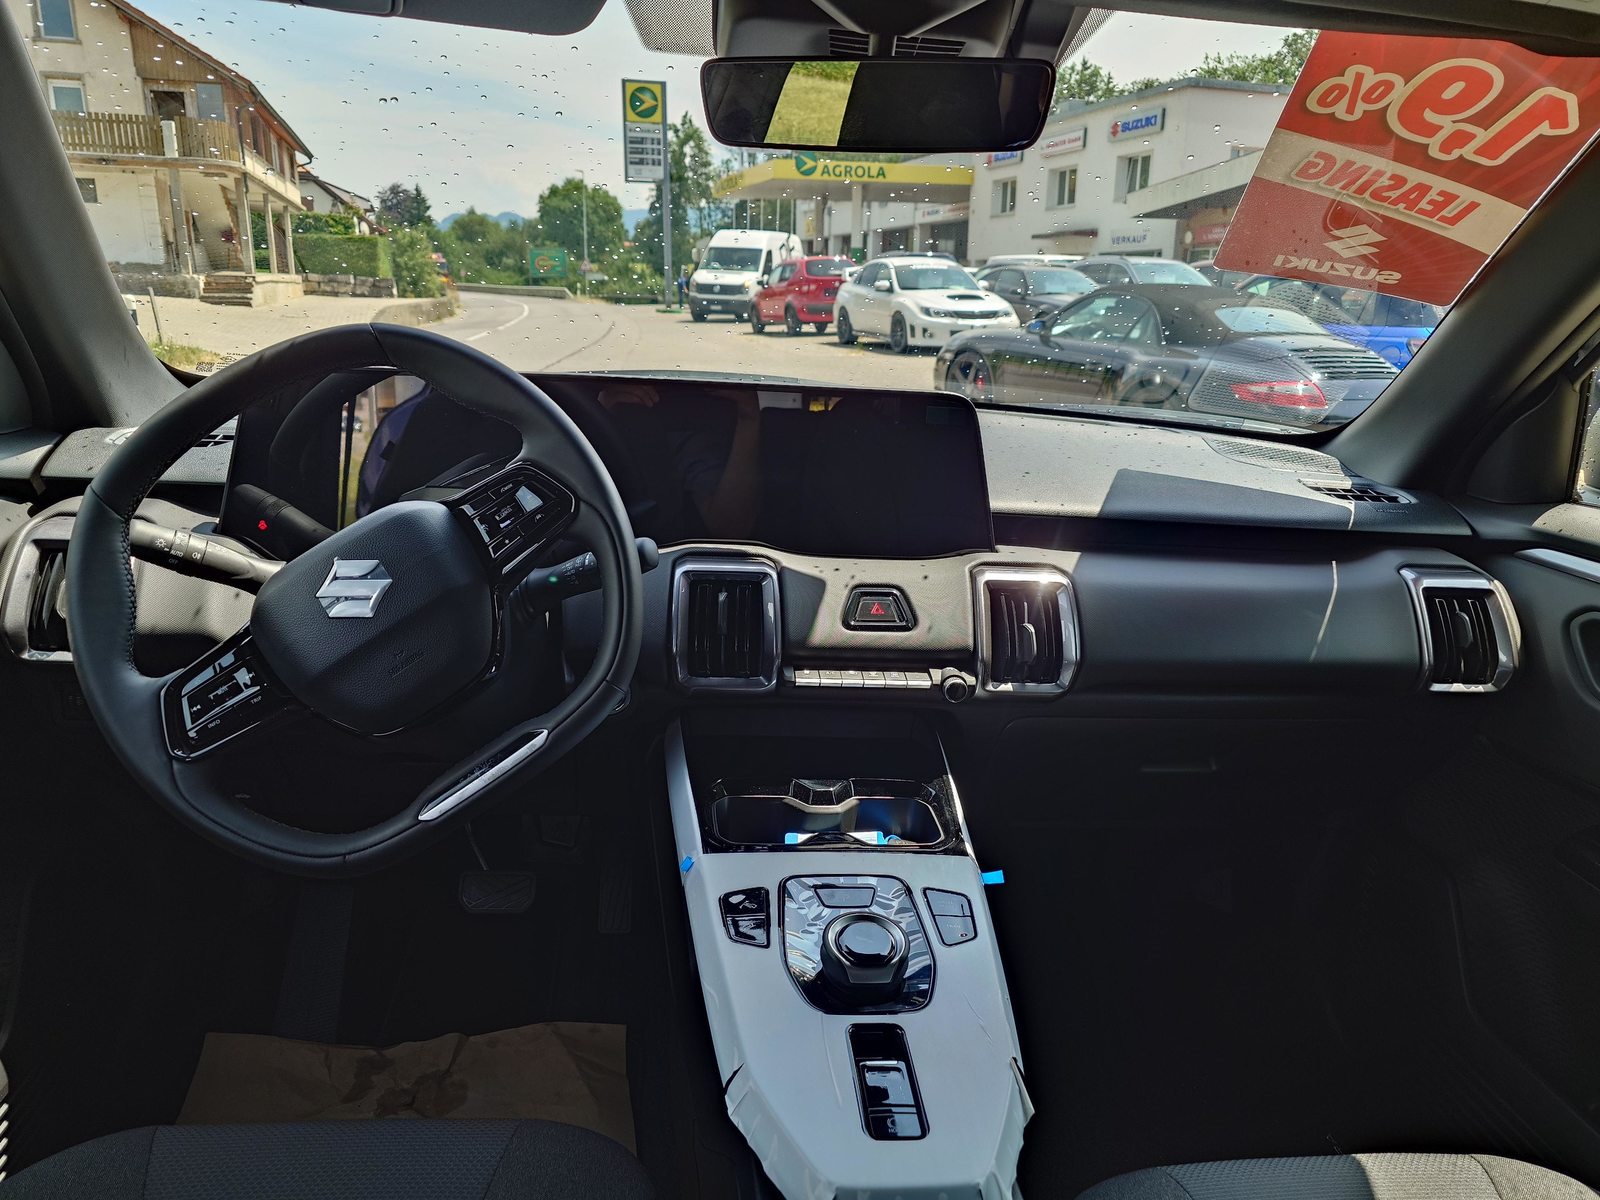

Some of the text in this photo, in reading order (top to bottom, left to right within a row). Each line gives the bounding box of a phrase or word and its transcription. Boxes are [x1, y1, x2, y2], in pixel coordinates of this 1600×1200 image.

[1121, 115, 1157, 132] SUZUKI
[820, 164, 886, 179] AGROLA
[1111, 234, 1147, 245] VERKAUF
[170, 550, 184, 558] AUTO
[250, 695, 262, 704] TRIP
[207, 719, 221, 729] INFO
